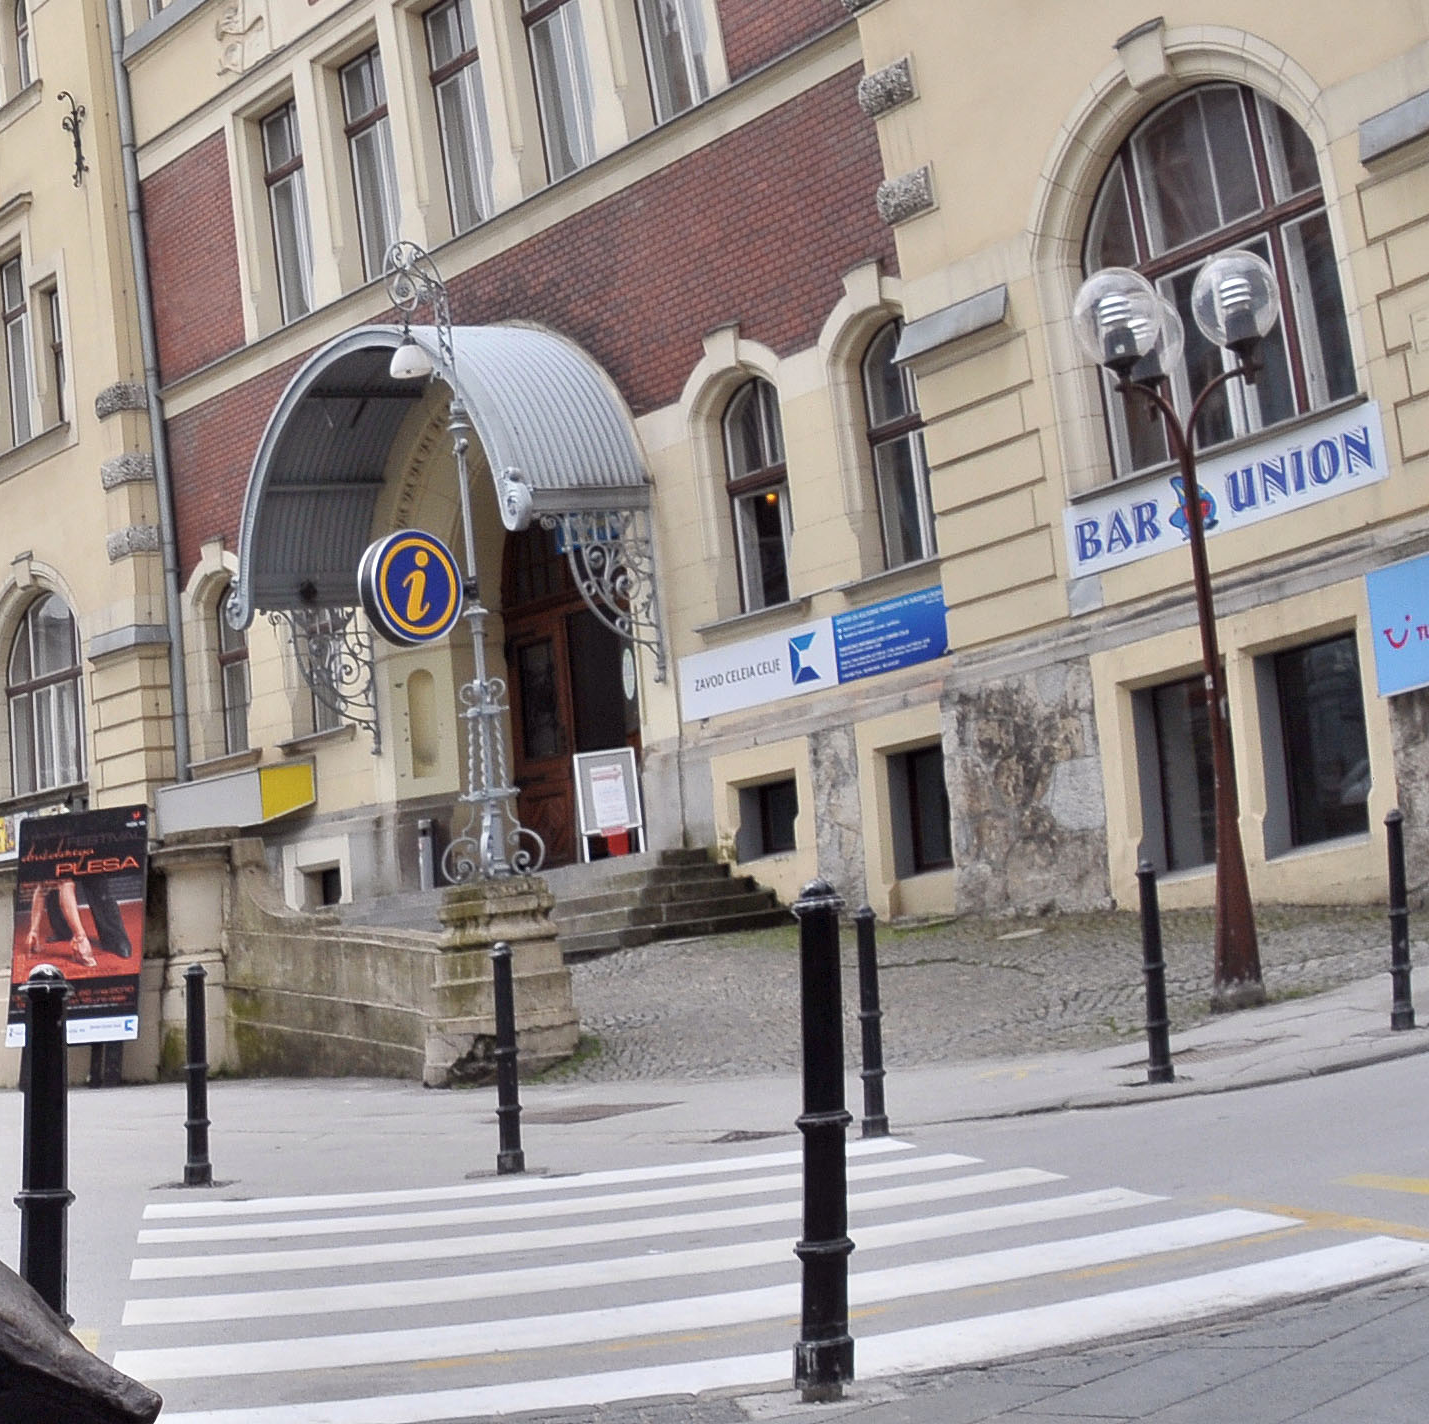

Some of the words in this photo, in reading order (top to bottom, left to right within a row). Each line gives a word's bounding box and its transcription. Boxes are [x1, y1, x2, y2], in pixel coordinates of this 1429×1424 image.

[1074, 498, 1162, 565] BAR
[1225, 426, 1377, 513] UNION
[695, 673, 724, 692] ZAVOD
[725, 665, 755, 684] CELEIA
[757, 658, 782, 676] CELJE
[55, 856, 140, 877] PLESA
